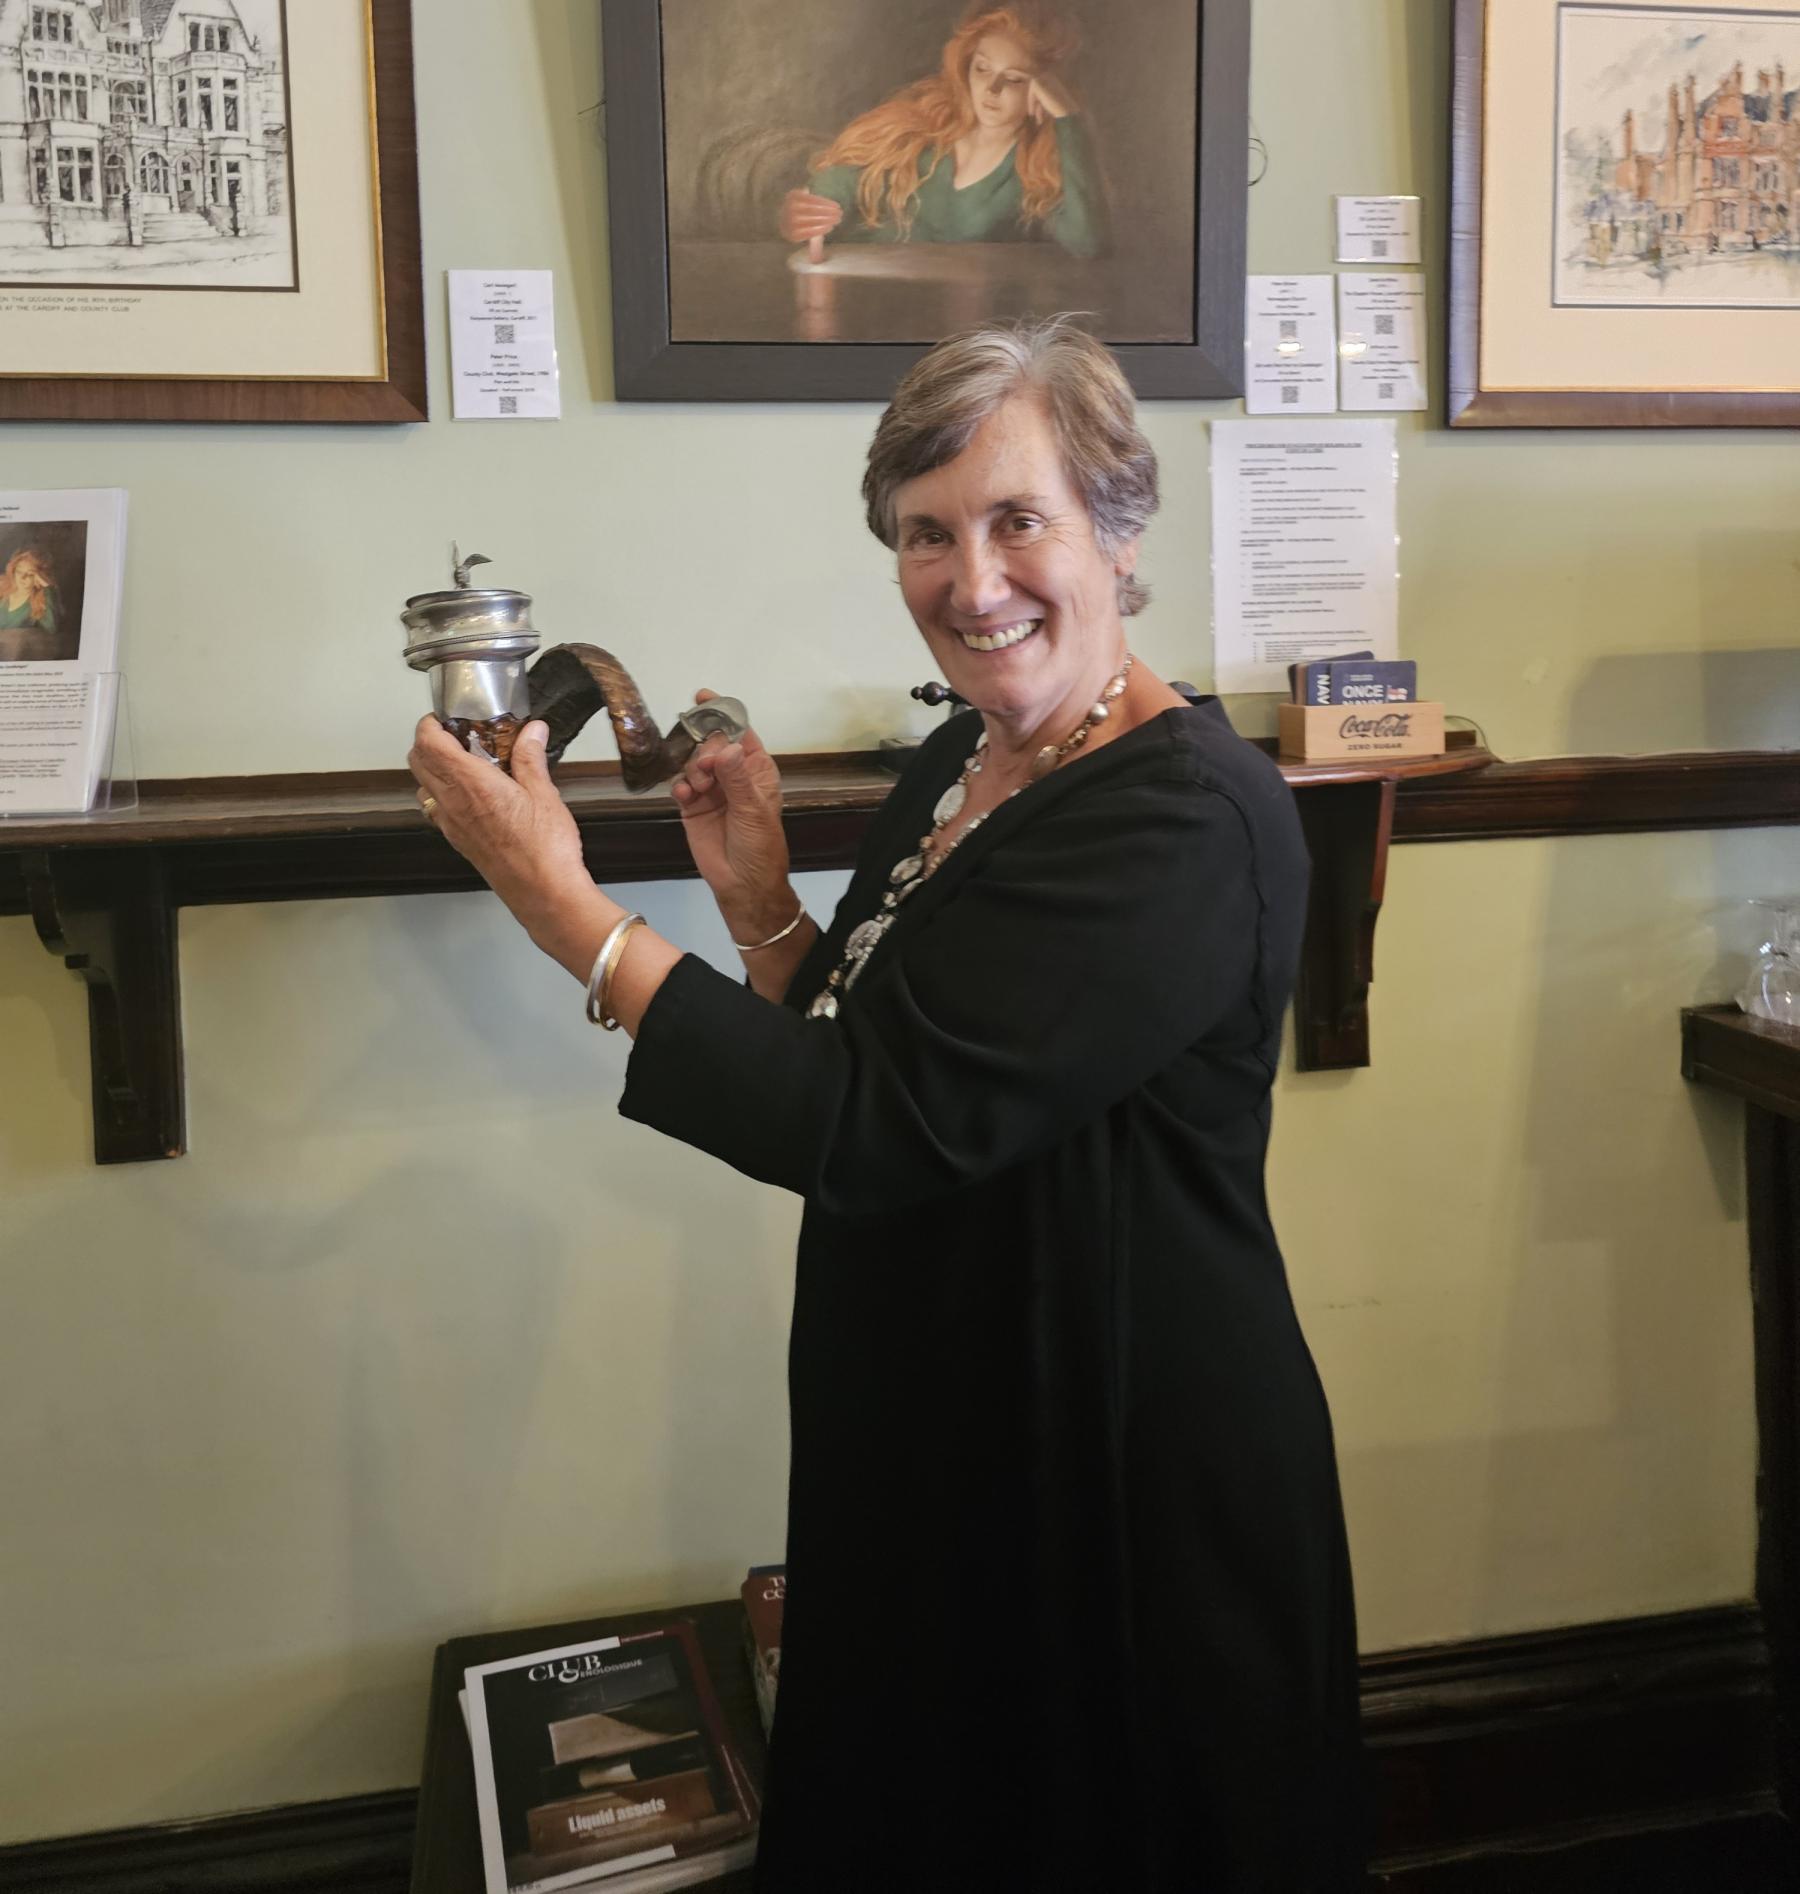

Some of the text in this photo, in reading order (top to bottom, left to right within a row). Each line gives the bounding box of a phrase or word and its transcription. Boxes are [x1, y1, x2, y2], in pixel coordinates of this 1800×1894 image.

[1342, 684, 1384, 698] ONCE
[1373, 742, 1402, 750] SUGAR
[568, 1807, 616, 1834] Liquid
[616, 1798, 666, 1822] assets
